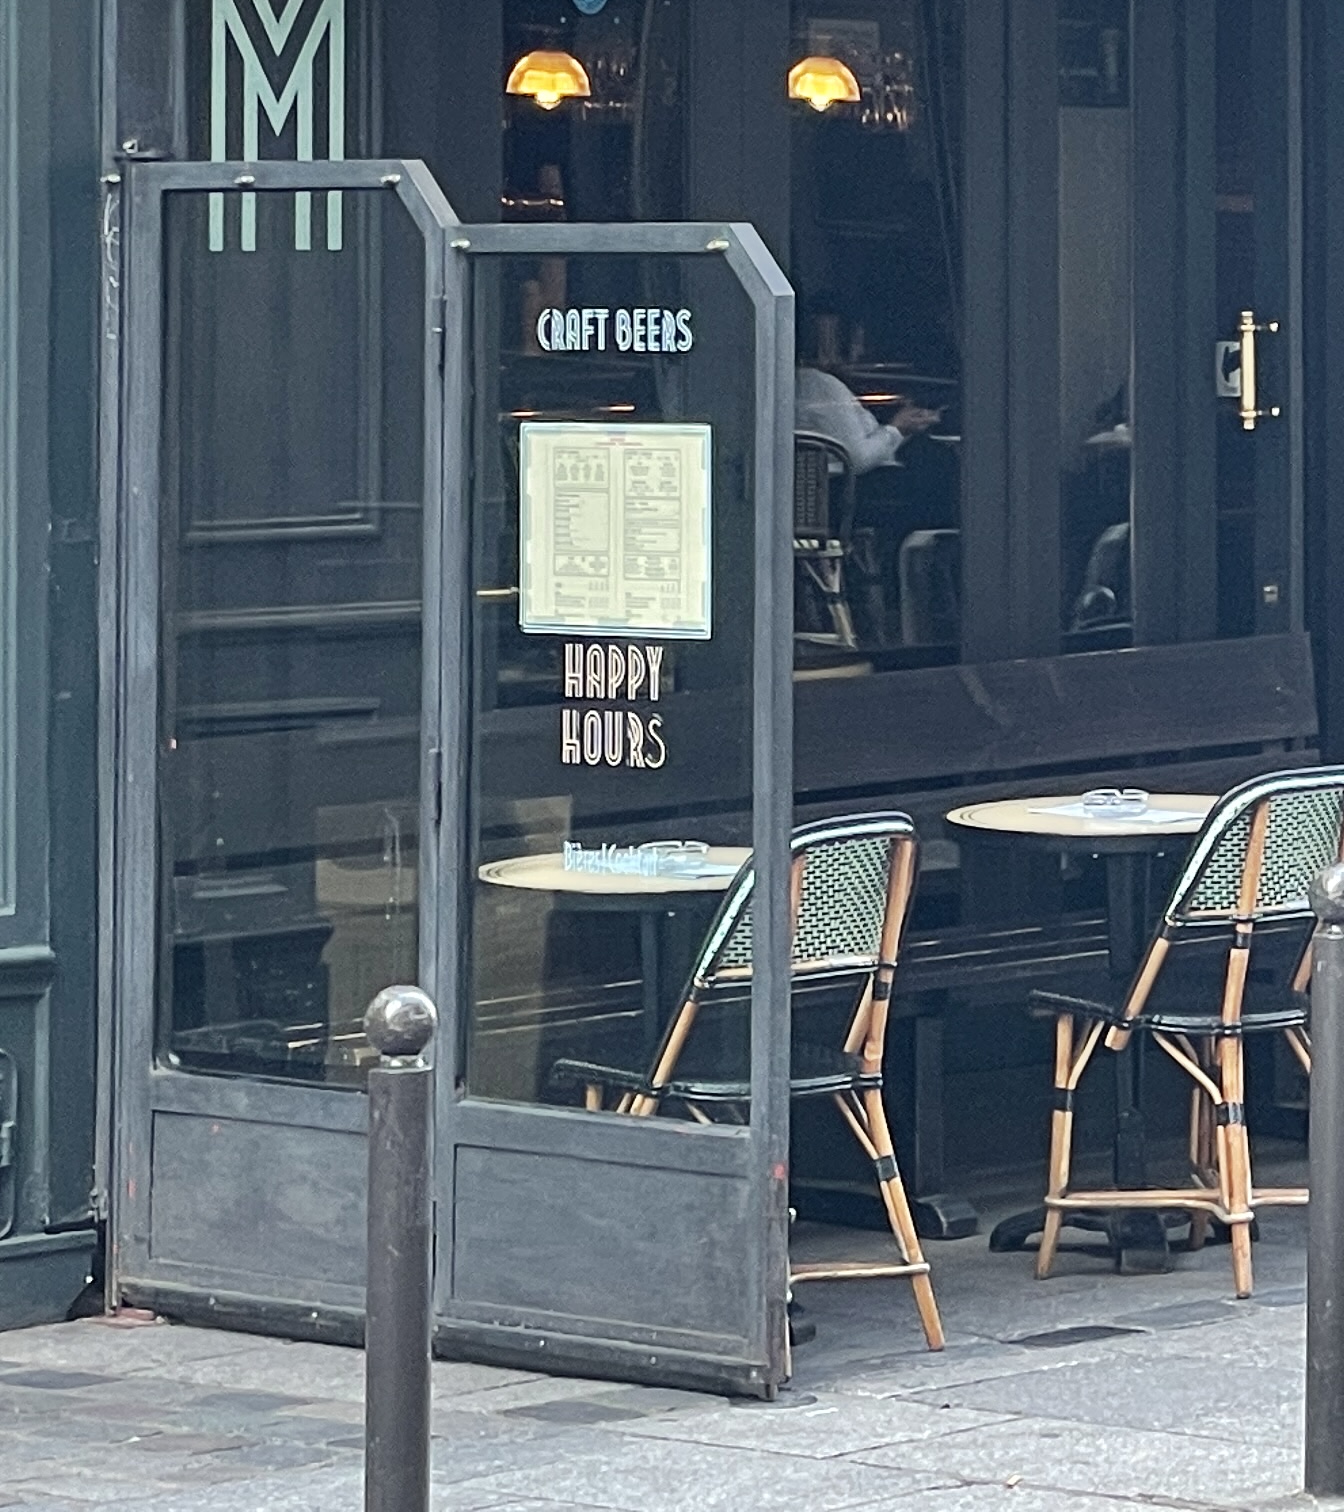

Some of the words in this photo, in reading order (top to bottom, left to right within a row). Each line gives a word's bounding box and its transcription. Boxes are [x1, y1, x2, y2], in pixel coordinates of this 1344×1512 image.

[536, 308, 610, 351] CRAFT
[615, 308, 693, 352] BEERS
[564, 643, 664, 702] HAPPY
[561, 708, 668, 769] HOURS
